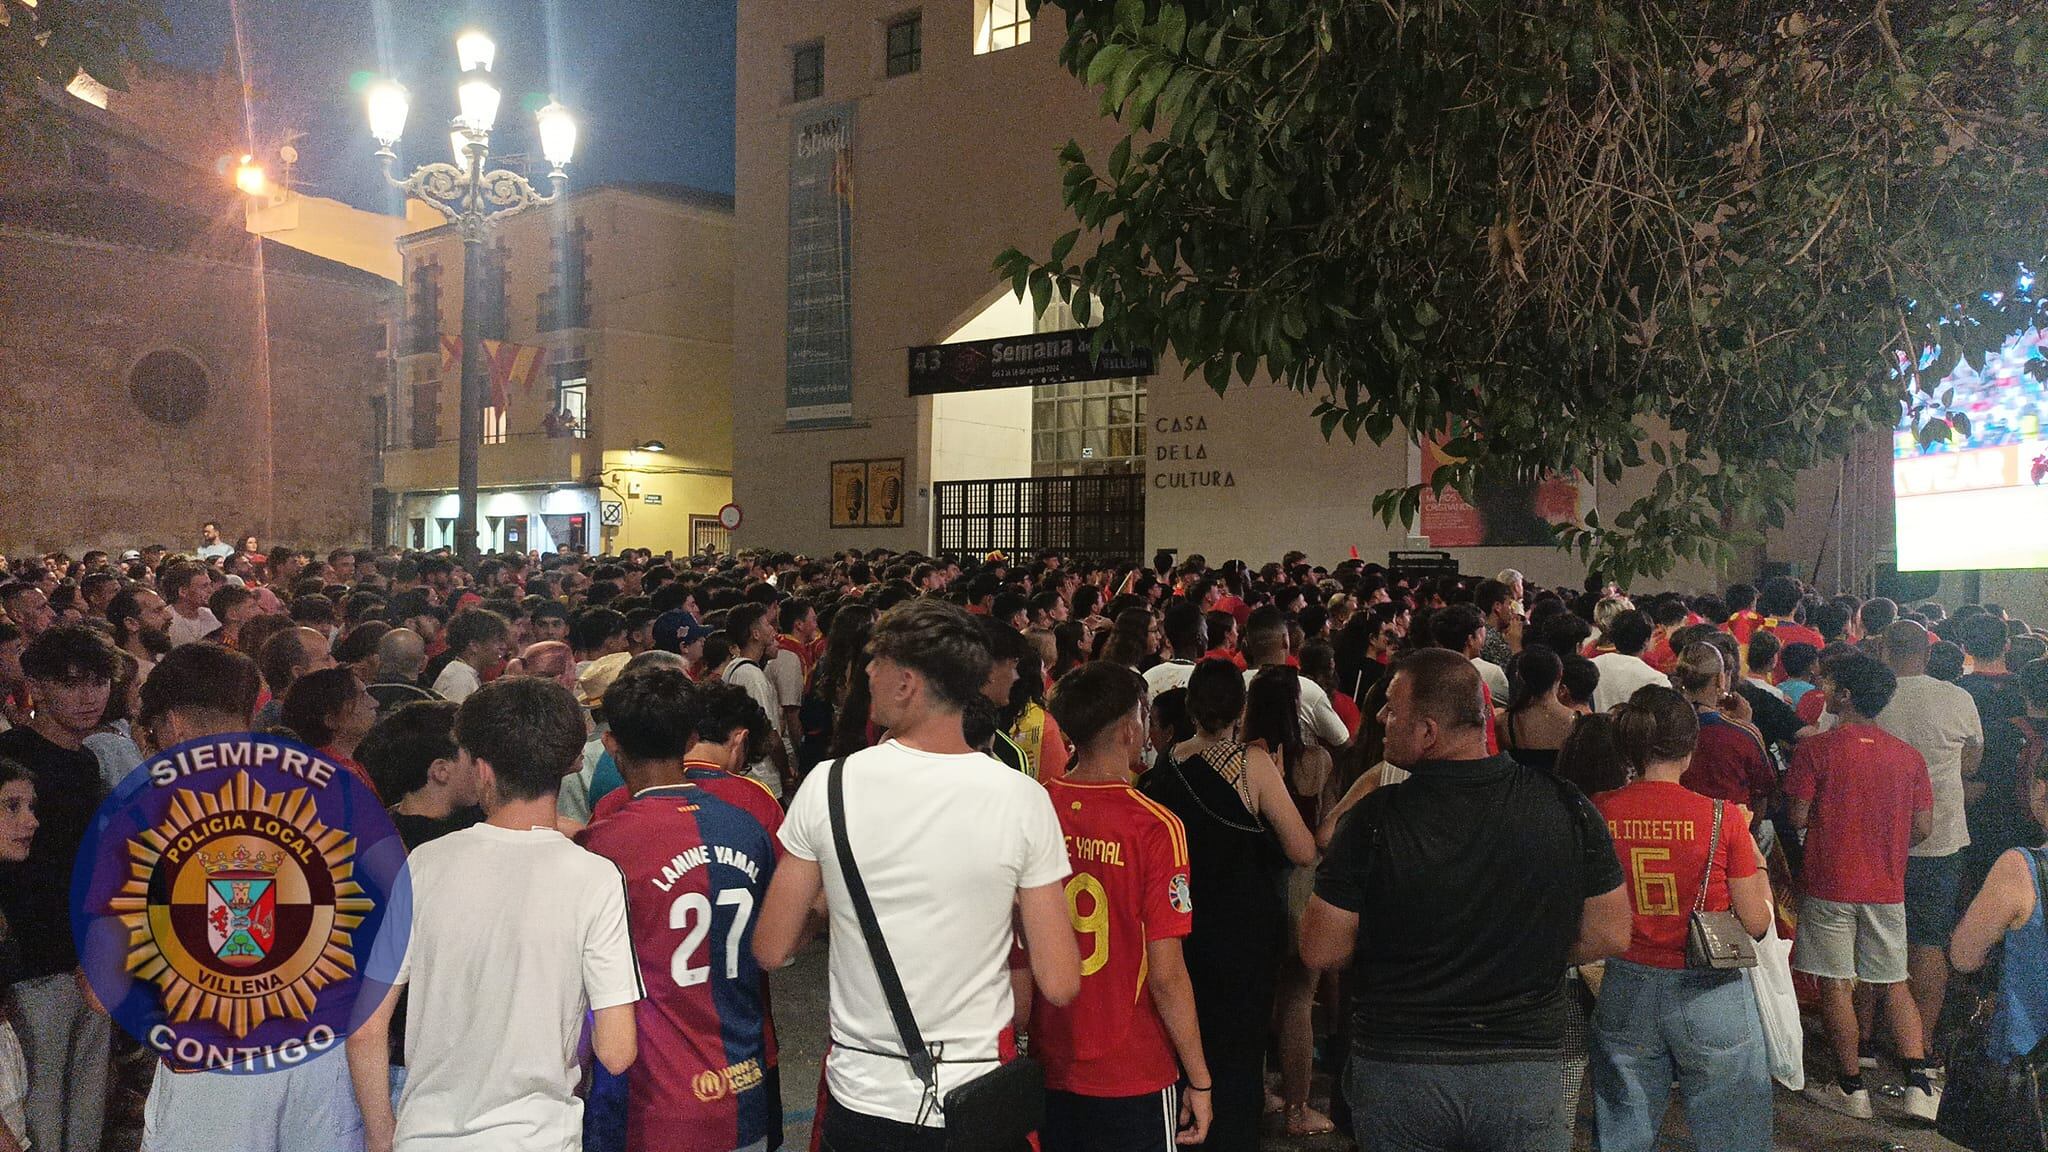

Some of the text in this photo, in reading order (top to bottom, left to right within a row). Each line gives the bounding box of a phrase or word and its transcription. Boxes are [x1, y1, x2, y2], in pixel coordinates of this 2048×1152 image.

[991, 339, 1073, 364] Semana
[1156, 416, 1207, 433] CASA
[1157, 444, 1207, 461] DE LA
[1155, 470, 1236, 489] CULTURA
[1076, 836, 1125, 867] YAMAL
[652, 845, 761, 893] LAMINE YAMAL
[1630, 847, 1680, 916] 6
[669, 887, 754, 988] 27
